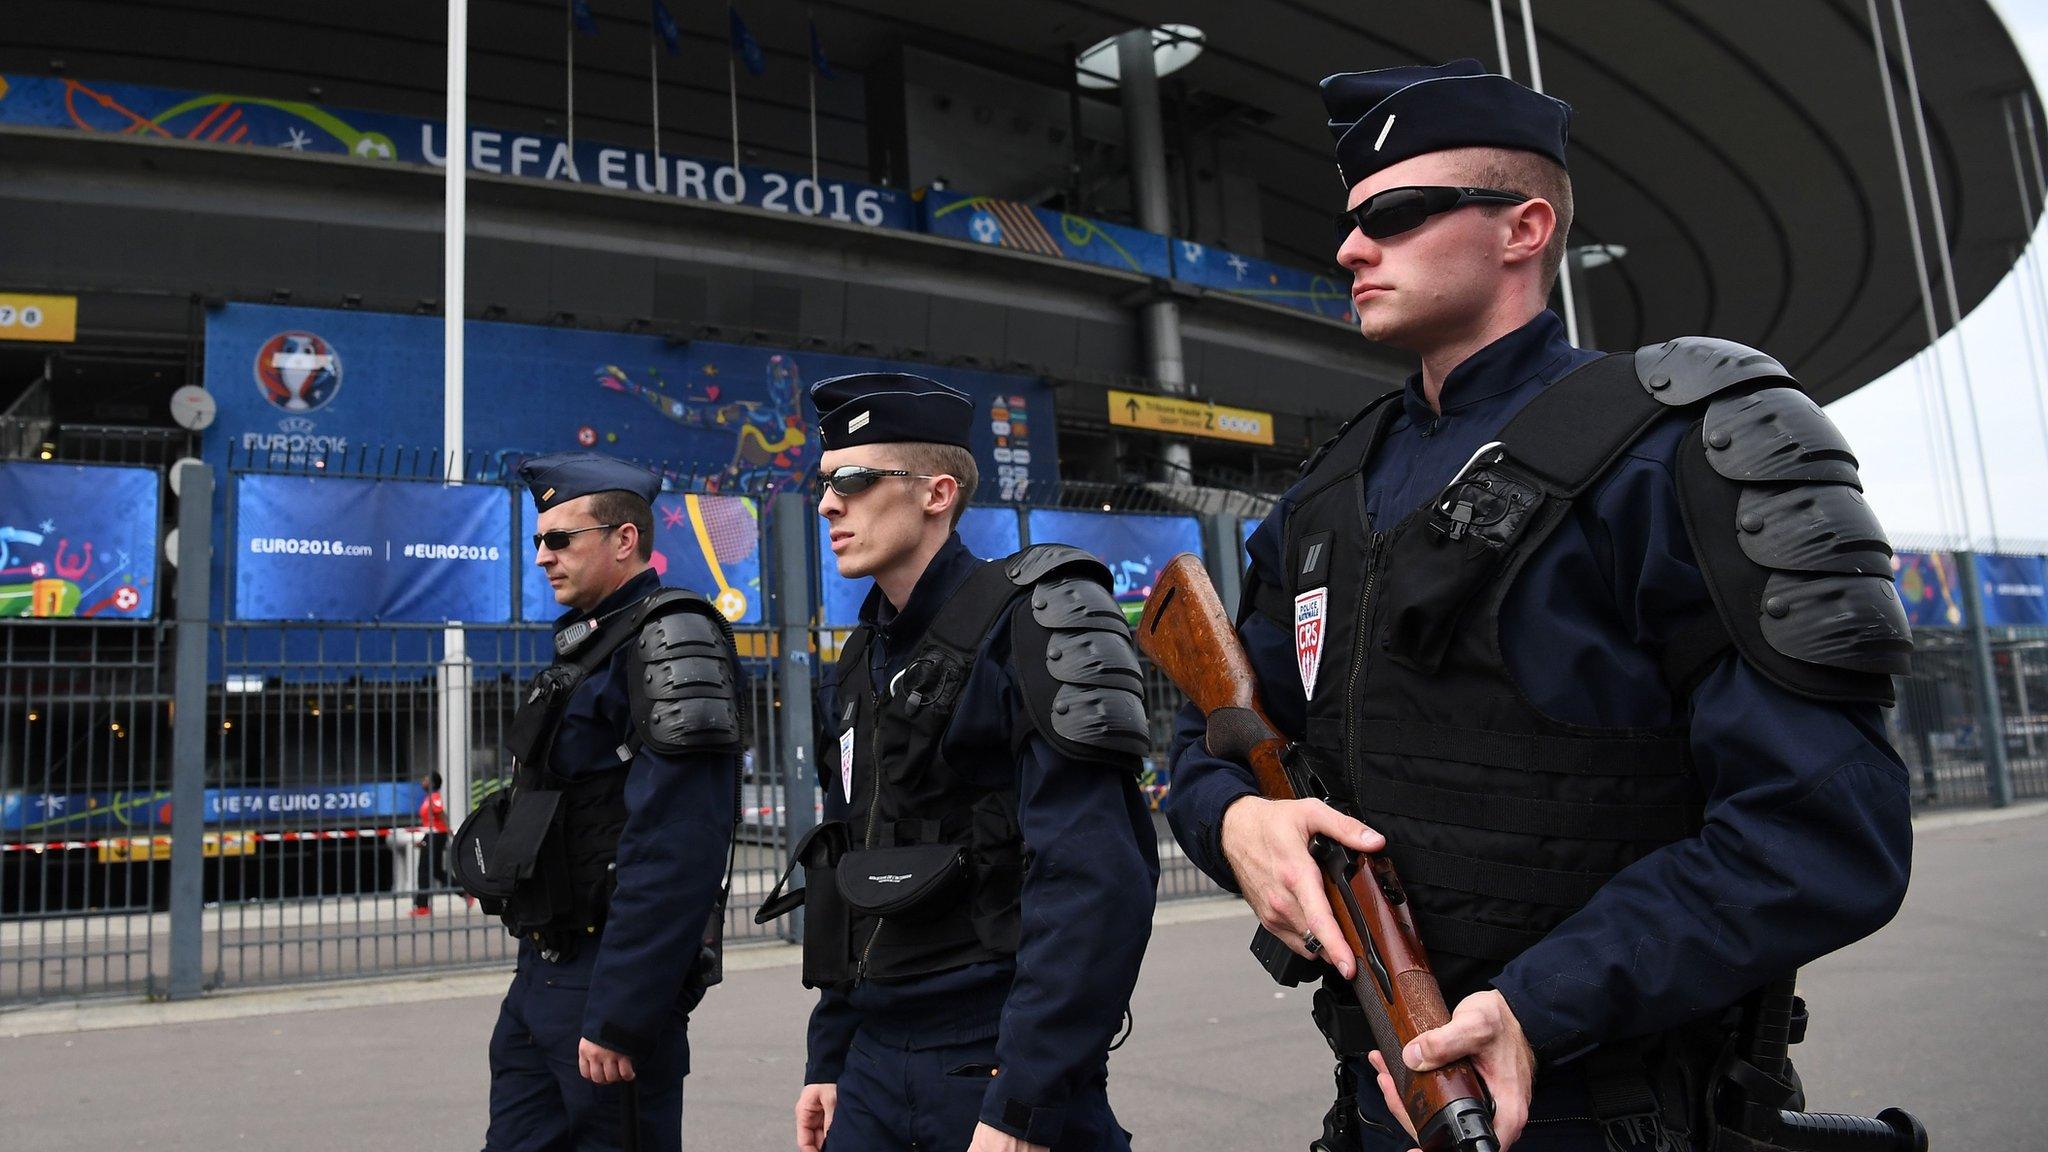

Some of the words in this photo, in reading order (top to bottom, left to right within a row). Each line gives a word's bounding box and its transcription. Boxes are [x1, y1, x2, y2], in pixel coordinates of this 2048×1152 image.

[421, 124, 580, 183] UEFA
[599, 149, 747, 203] EURO
[762, 174, 884, 226] 2016
[251, 537, 373, 557] EURO2016.com
[403, 543, 499, 560] #EURO2016
[1299, 621, 1318, 650] CRS
